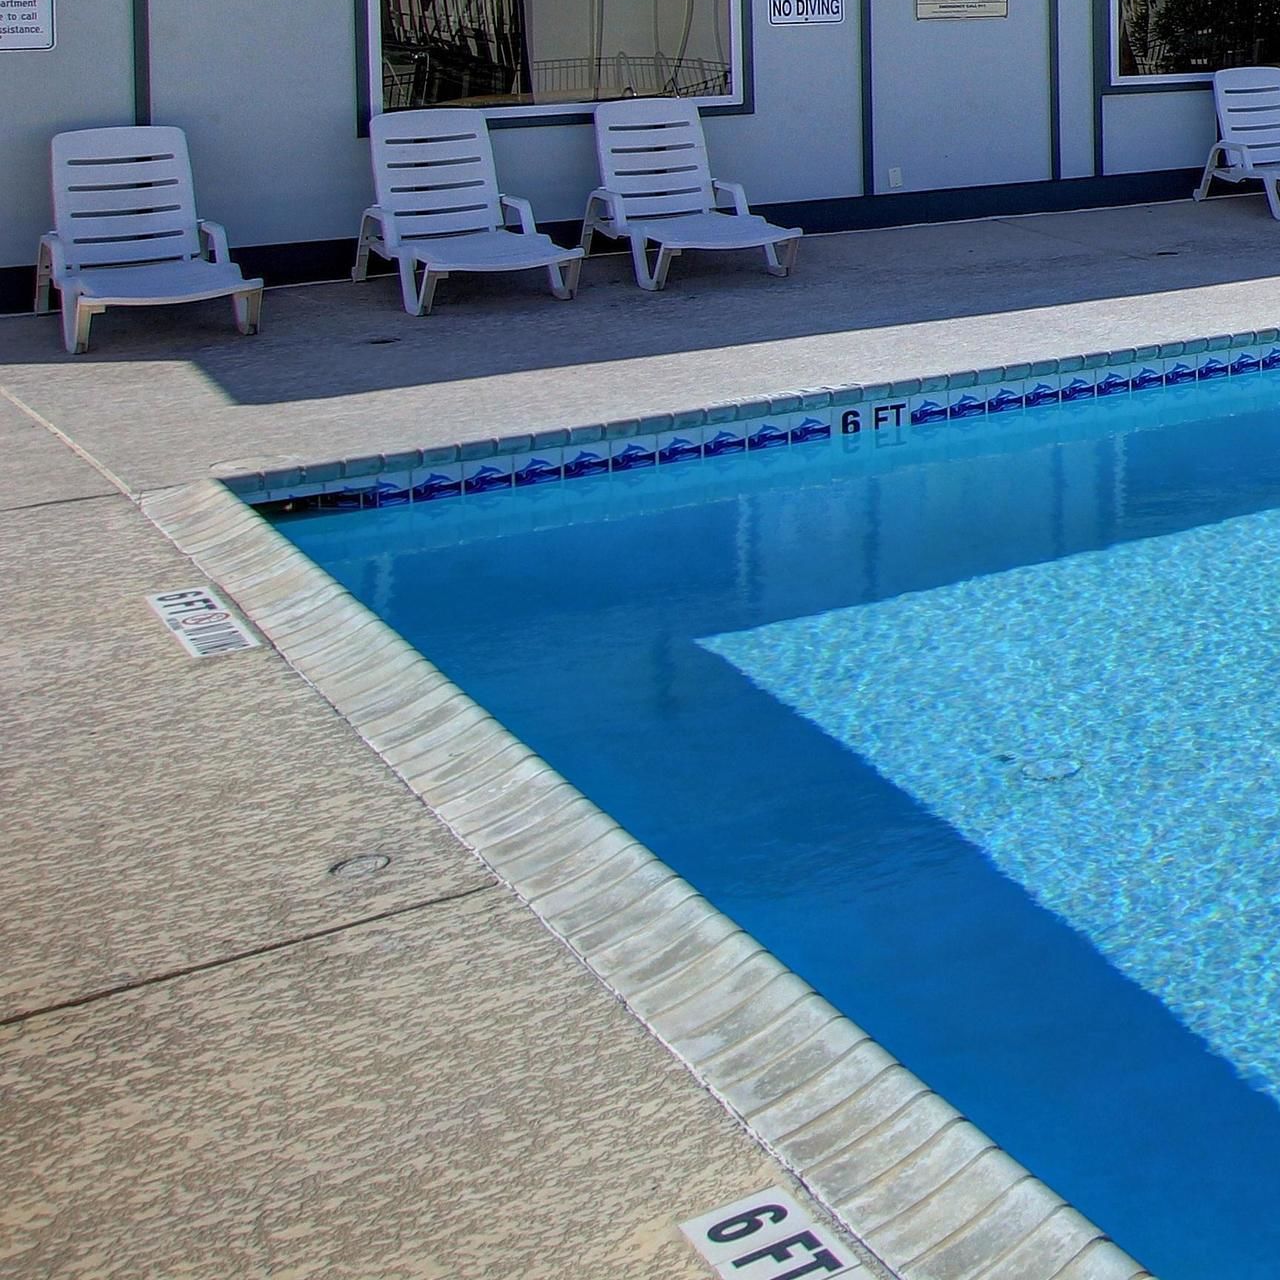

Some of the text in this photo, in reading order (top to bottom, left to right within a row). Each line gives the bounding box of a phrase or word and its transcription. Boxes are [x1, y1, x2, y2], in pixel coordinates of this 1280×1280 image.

[8, 12, 17, 20] to
[21, 12, 37, 20] call
[773, 0, 792, 17] NO
[842, 403, 906, 434] 6 FT
[156, 590, 218, 615] 6 FT
[707, 1204, 844, 1280] 6 FT
